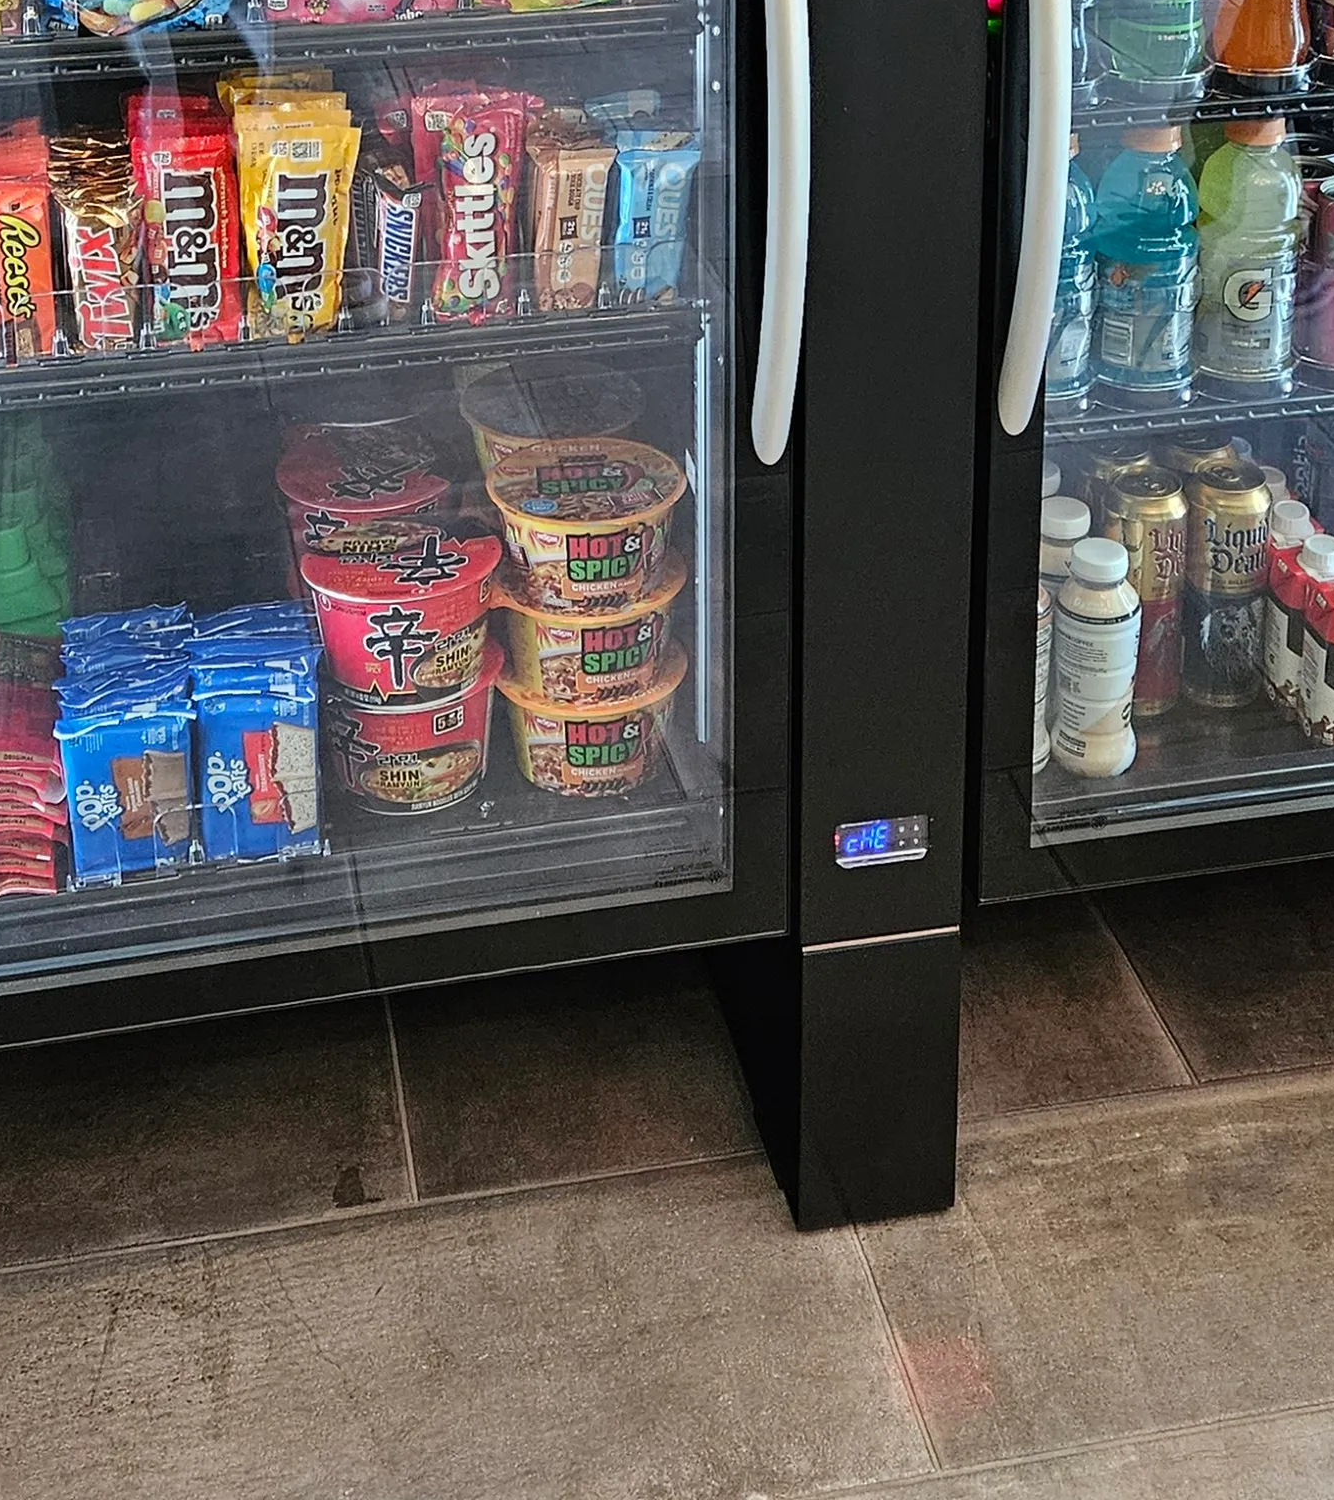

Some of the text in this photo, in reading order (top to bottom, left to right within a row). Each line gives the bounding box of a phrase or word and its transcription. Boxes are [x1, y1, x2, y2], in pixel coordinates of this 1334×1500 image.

[456, 130, 498, 300] Skittles
[162, 168, 221, 330] m&m's
[275, 172, 330, 314] m&m's
[381, 201, 415, 302] SNICKERS
[75, 226, 134, 351] TWIX
[1222, 268, 1274, 322] G
[539, 466, 602, 479] HOT
[541, 477, 623, 494] SPICY
[568, 534, 641, 559] HOT &
[1204, 517, 1268, 555] Liquid
[570, 554, 639, 581] SPICY
[572, 581, 616, 591] CHICKEN
[364, 605, 440, 690] 辛
[584, 623, 655, 651] HOT &
[436, 646, 471, 666] SHIN
[583, 644, 650, 673] SPICY
[584, 672, 631, 685] CHICKEN
[438, 717, 446, 729] 5
[568, 721, 640, 744] HOT &
[568, 741, 637, 765] SPICY
[380, 770, 419, 781] SHIN
[570, 766, 618, 778] CHICKEN
